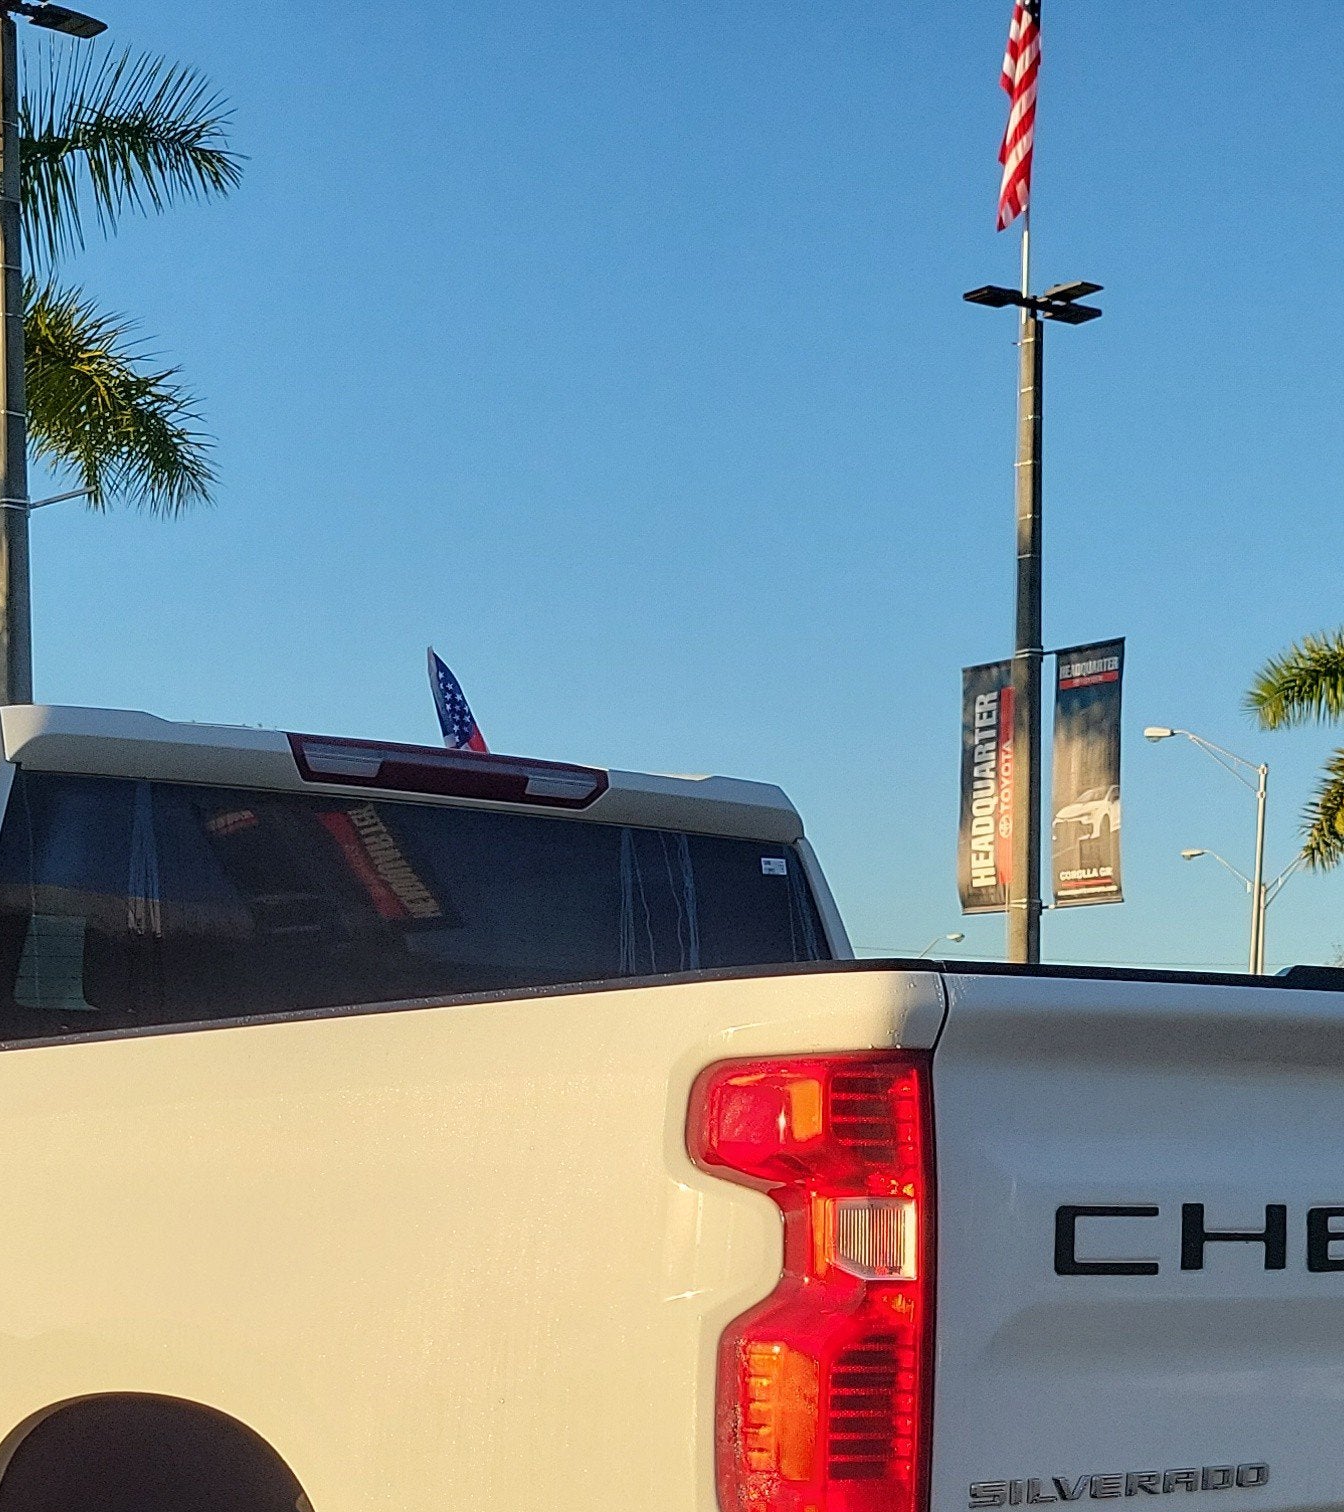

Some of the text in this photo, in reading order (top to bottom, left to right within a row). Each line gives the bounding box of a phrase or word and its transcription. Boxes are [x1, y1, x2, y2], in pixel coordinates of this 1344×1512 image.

[971, 691, 999, 888] HEADQUARTER
[1000, 739, 1014, 814] TOYOTA
[968, 1462, 1270, 1509] SILVERADO
